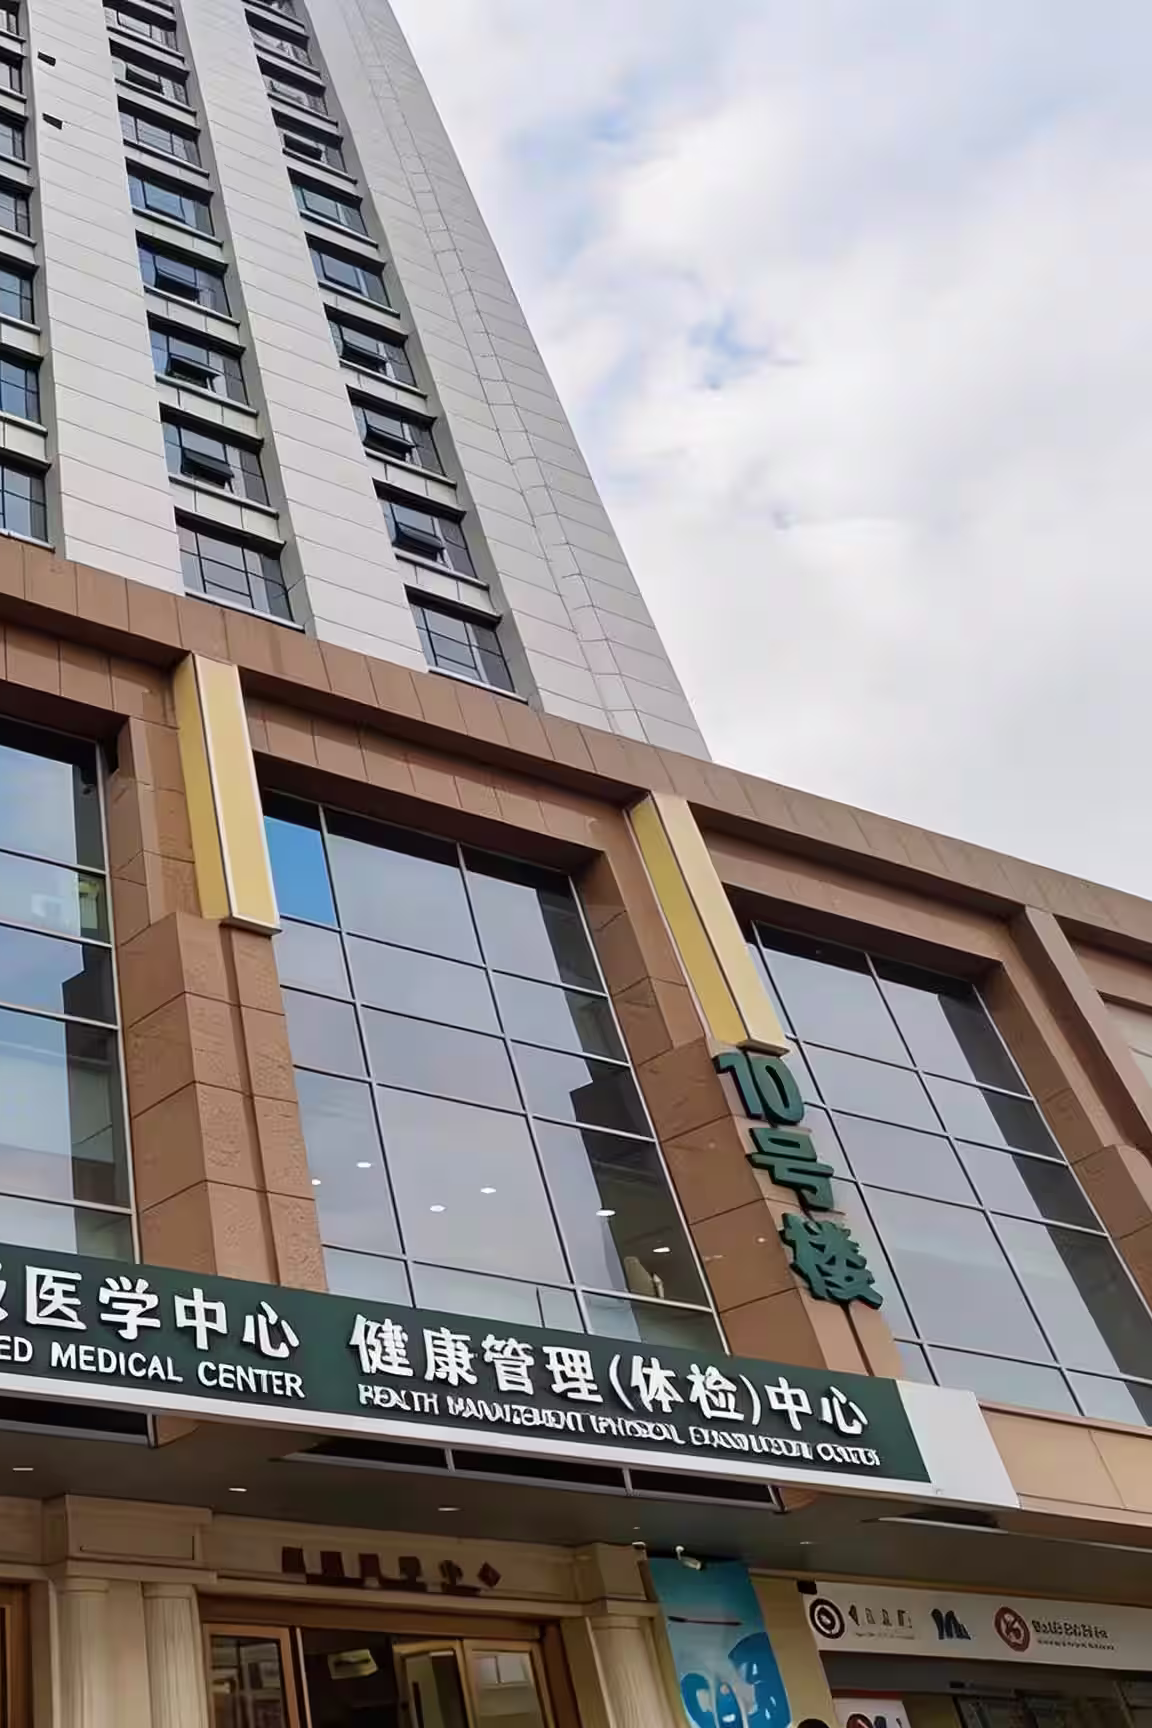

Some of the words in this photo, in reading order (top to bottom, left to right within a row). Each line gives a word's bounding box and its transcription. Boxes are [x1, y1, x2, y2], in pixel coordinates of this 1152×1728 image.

[50, 1341, 184, 1383] MEDICAL
[197, 1361, 307, 1399] CENTER
[349, 1314, 868, 1435] 健康管理(体检)中心
